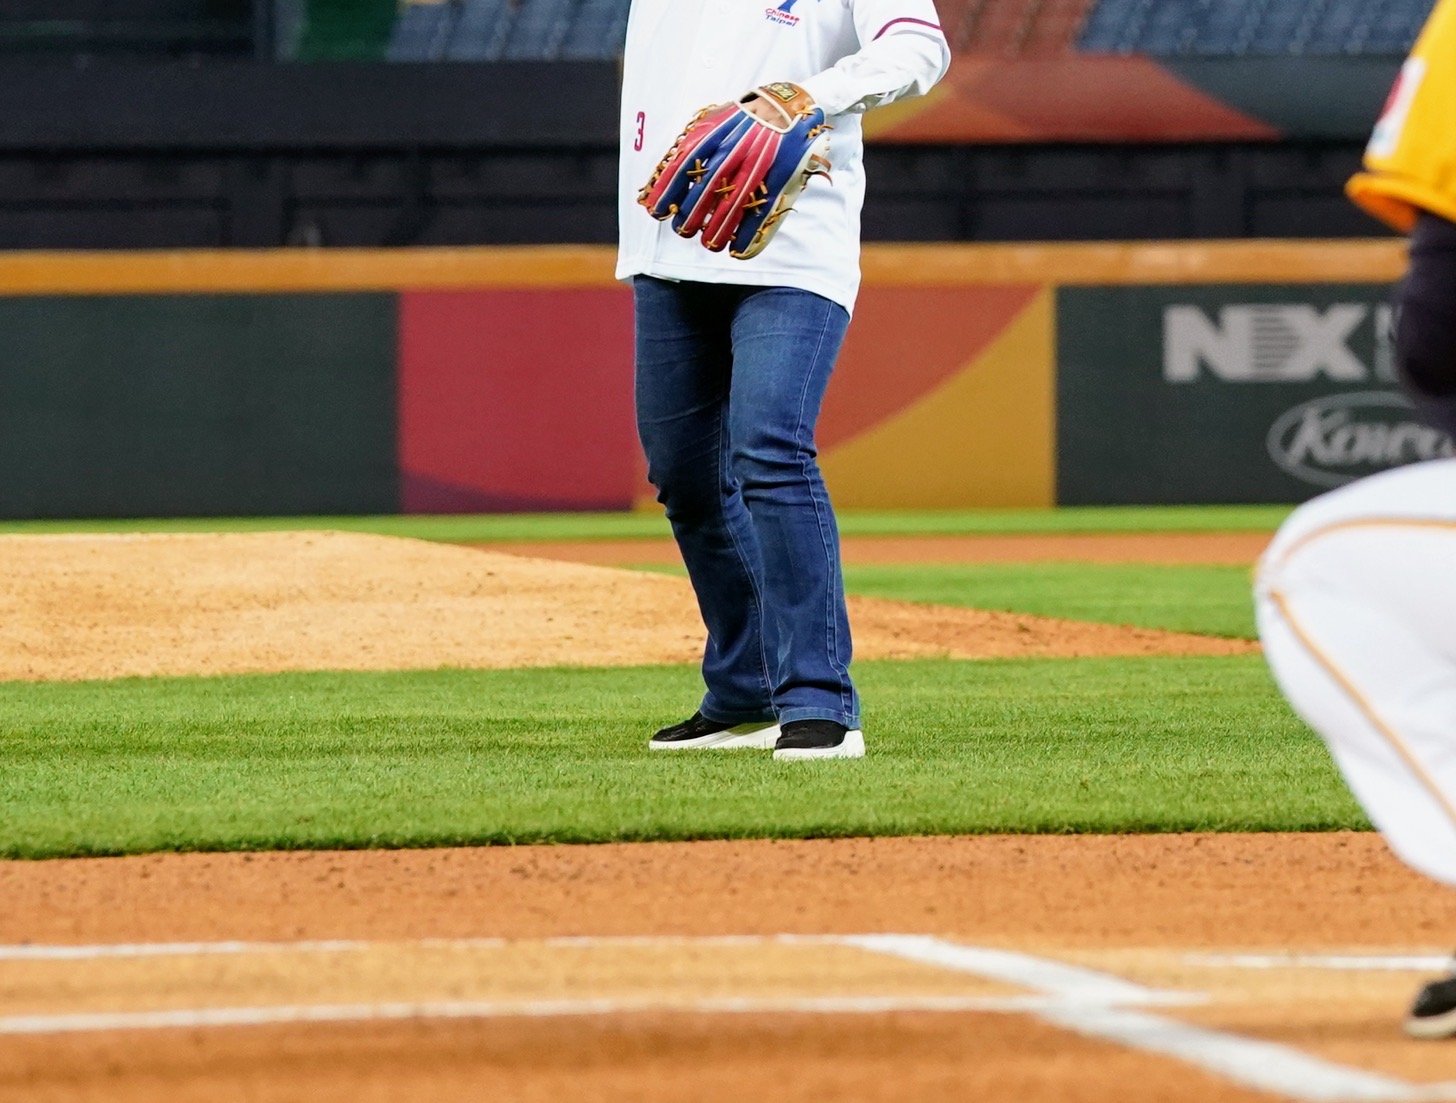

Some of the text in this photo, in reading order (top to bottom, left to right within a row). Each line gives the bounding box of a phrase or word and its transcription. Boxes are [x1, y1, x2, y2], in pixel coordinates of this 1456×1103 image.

[765, 8, 800, 22] Chinese
[765, 14, 797, 27] Taipei
[633, 110, 646, 152] 3
